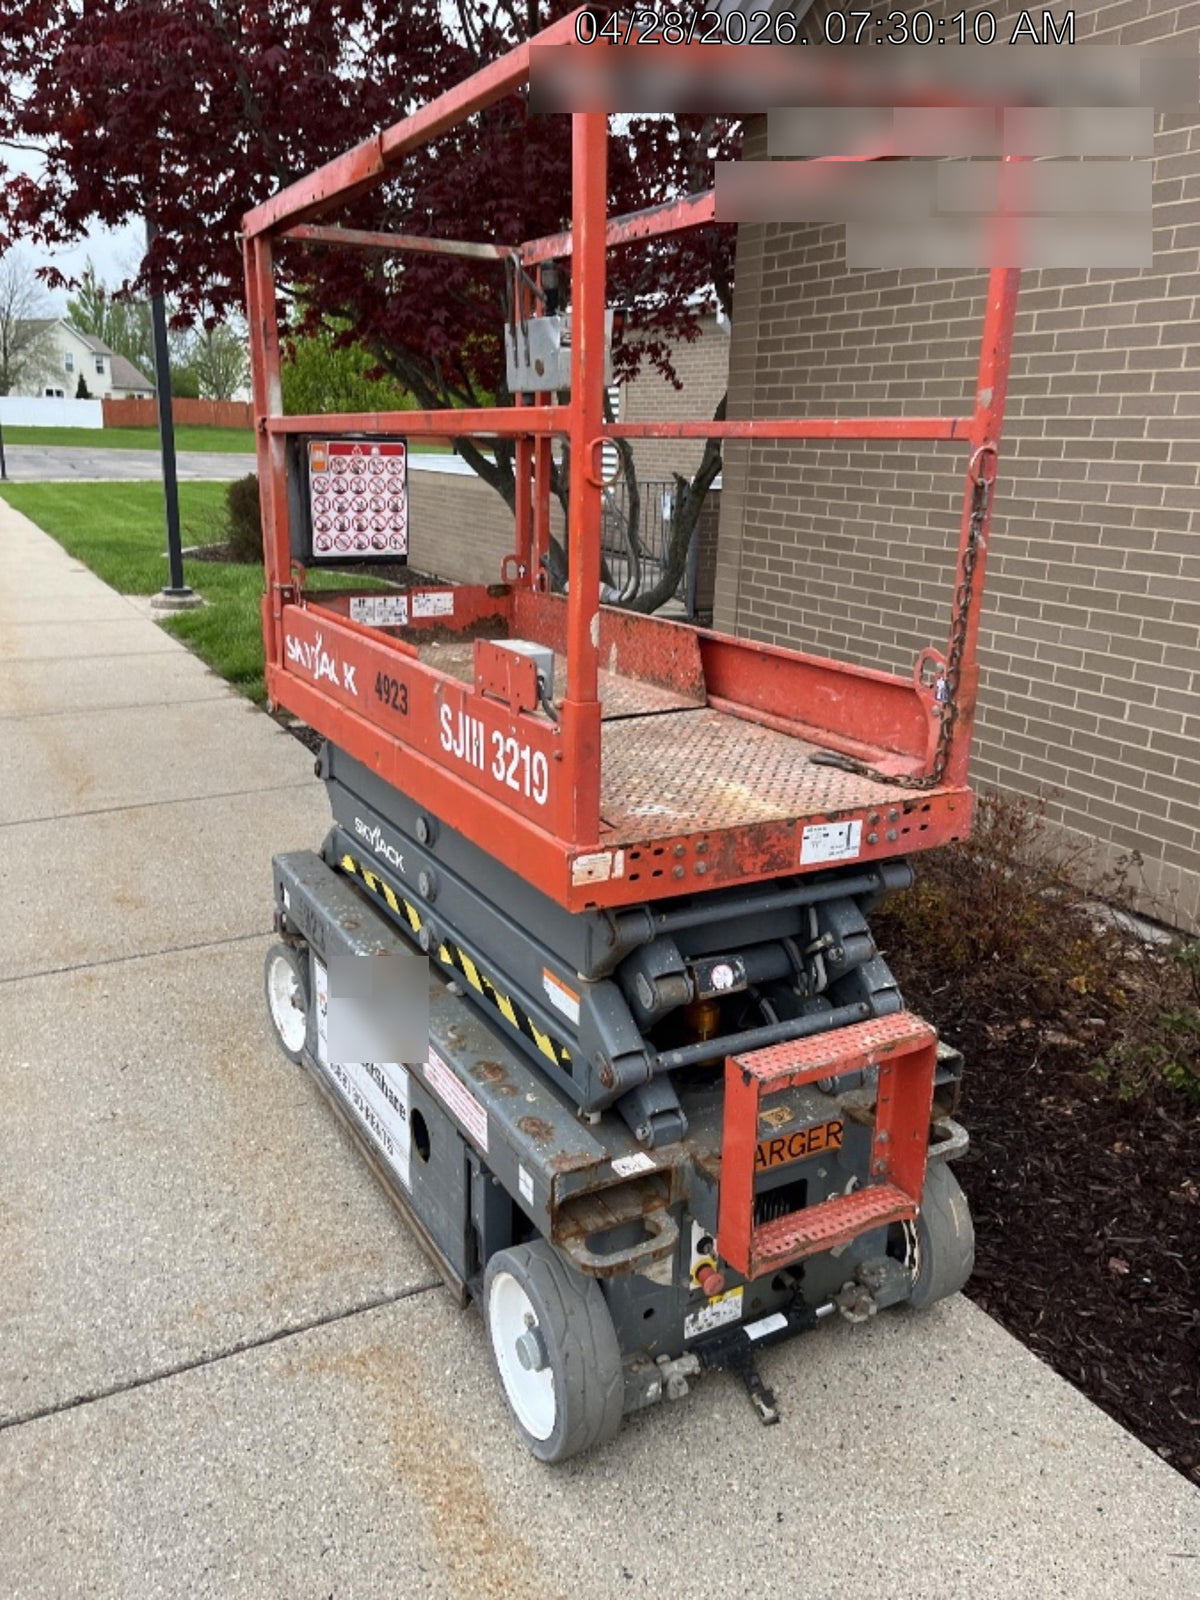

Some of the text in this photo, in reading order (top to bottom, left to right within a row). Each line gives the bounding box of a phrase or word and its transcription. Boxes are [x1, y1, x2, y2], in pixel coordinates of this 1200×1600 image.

[375, 671, 408, 716] 4923
[491, 730, 549, 806] 3219
[354, 816, 405, 874] SKYJACK
